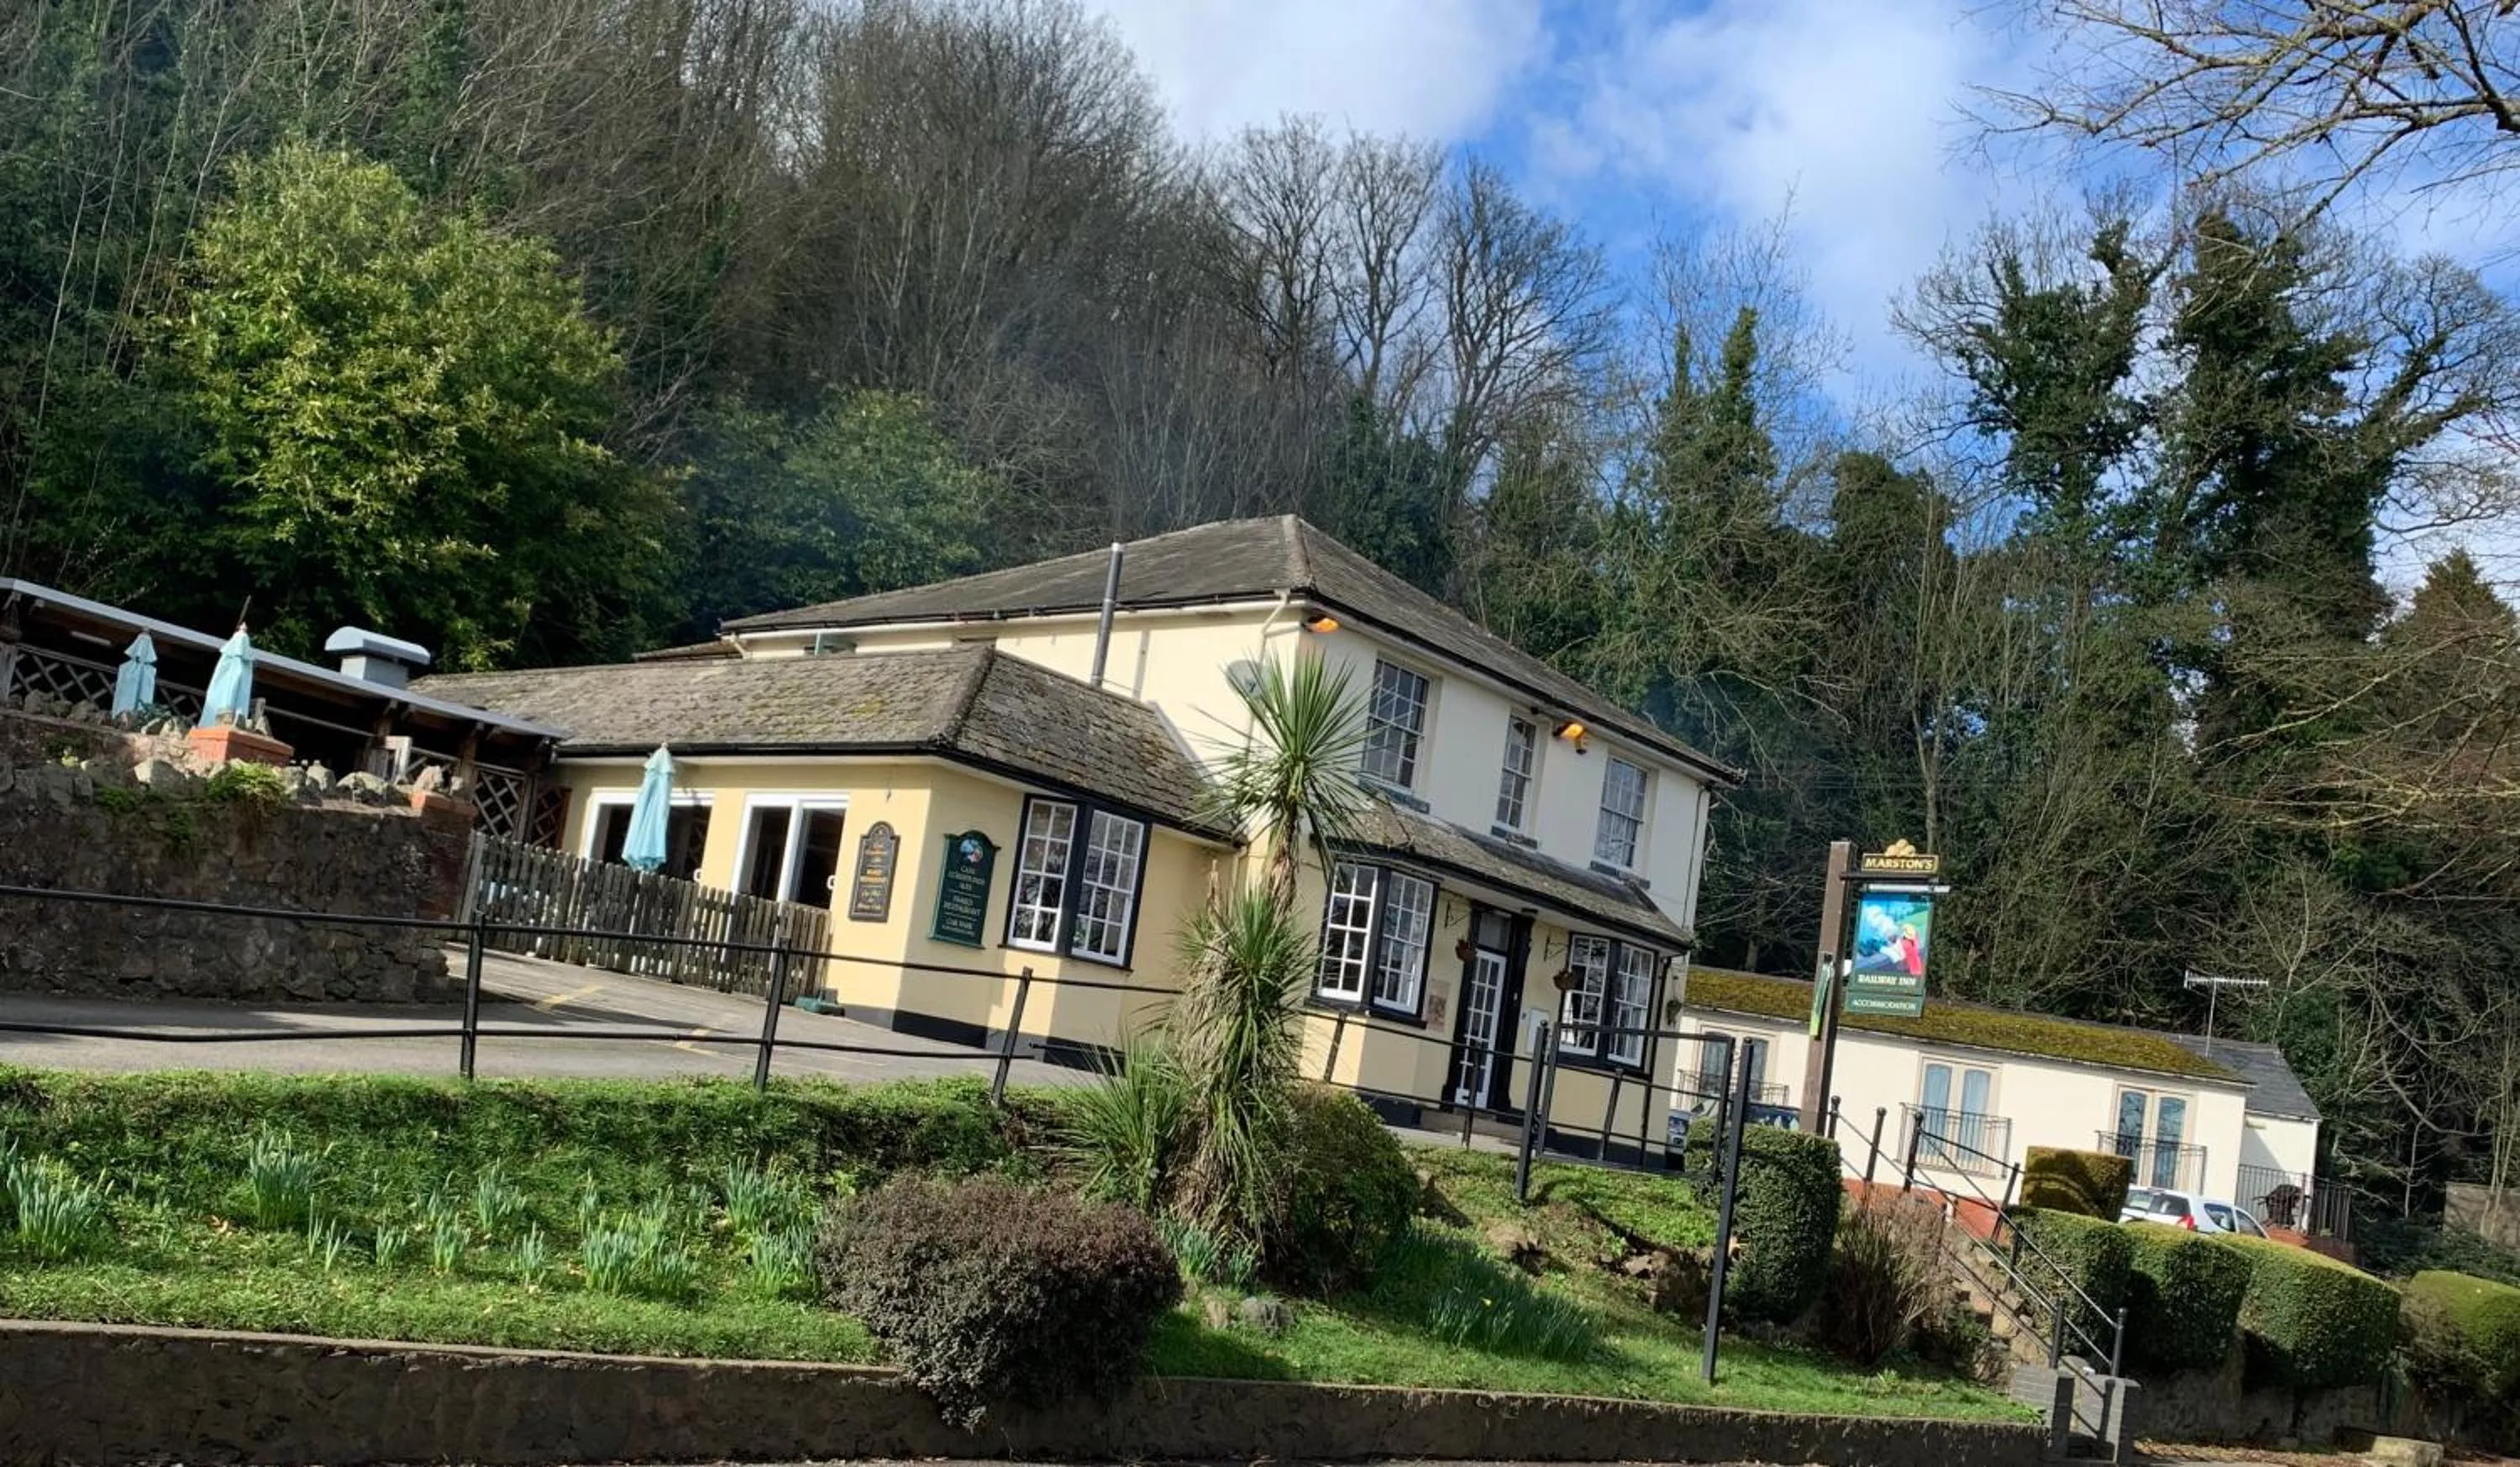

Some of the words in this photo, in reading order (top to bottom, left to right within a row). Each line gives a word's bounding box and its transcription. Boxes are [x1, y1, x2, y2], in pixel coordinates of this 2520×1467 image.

[1864, 858, 1933, 870] MARSTON'S
[1857, 974, 1897, 986] RAILWAY
[1898, 976, 1916, 986] INN
[1851, 999, 1916, 1011] ACCOMMODATION
